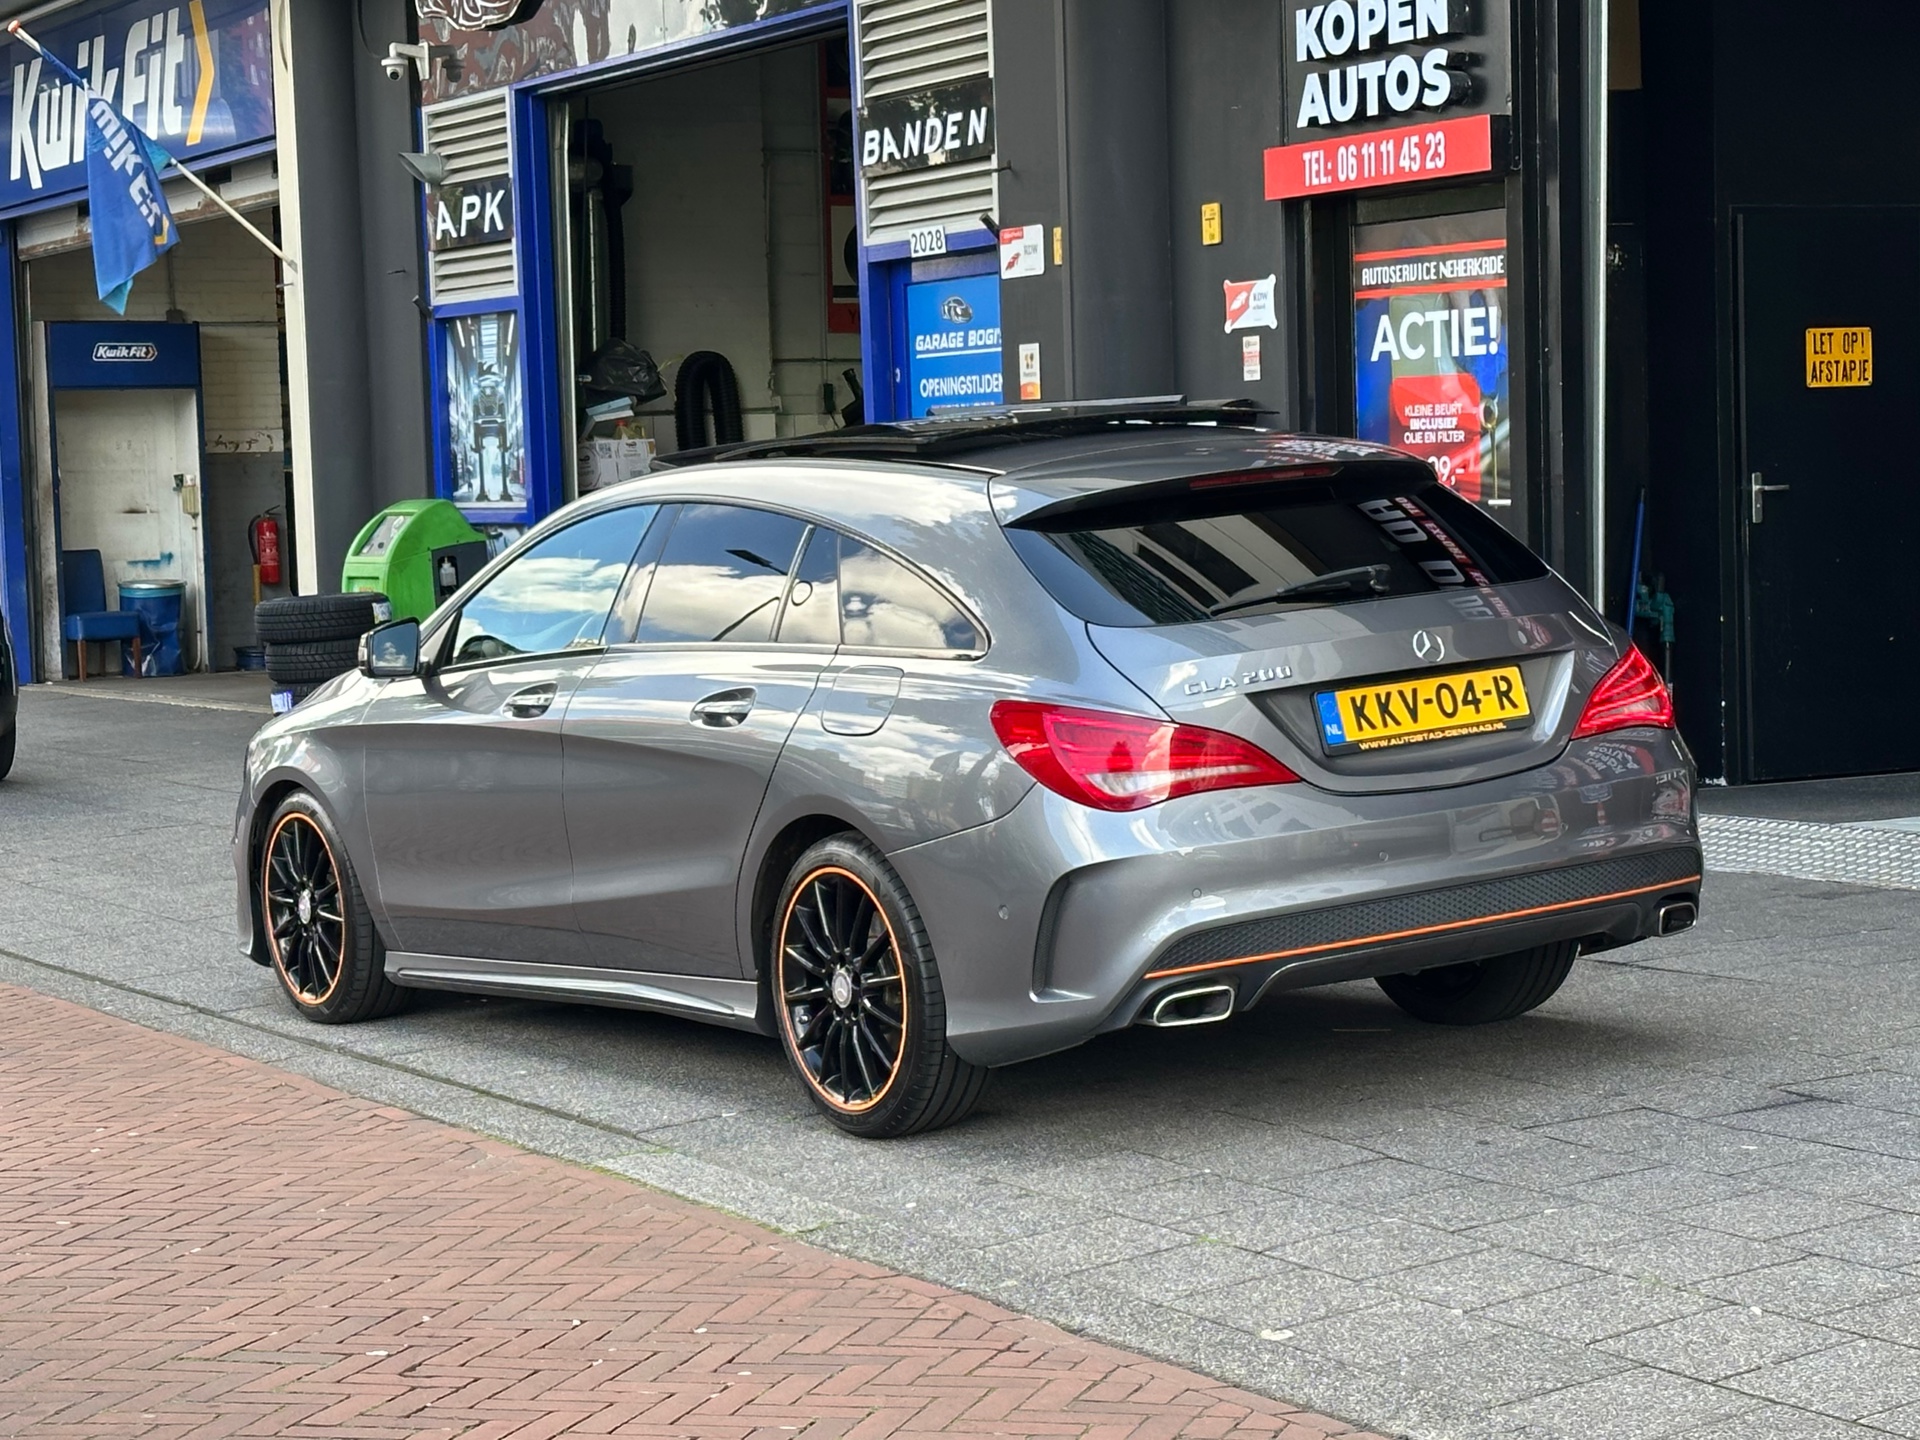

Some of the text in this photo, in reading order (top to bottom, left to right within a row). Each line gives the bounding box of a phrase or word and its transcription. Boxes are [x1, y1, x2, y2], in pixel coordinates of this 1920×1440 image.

[1296, 0, 1449, 62] KOPEN
[122, 7, 185, 141] Fit
[1296, 48, 1451, 128] AUTOS
[862, 106, 988, 166] BANDEN
[1302, 131, 1446, 187] TEL: 06 11 11 45 23
[436, 189, 506, 241] APK
[911, 229, 944, 254] 2028
[1362, 255, 1505, 286] AUTOSERVICE NEHERKADE
[915, 332, 965, 352] GARAGE
[1370, 306, 1499, 362] ACTIE!
[1813, 331, 1865, 355] LET OP!
[97, 345, 147, 359] Kwik Fit
[1811, 359, 1869, 383] AFSTAPJE
[1404, 402, 1463, 417] KLEINE BEURT
[1410, 417, 1458, 430] INCLUSIEF
[1404, 430, 1465, 444] OLIE EN FILTER
[1183, 665, 1293, 696] CLA 200
[1350, 674, 1519, 733] KKV-04-R
[1326, 724, 1343, 736] NL
